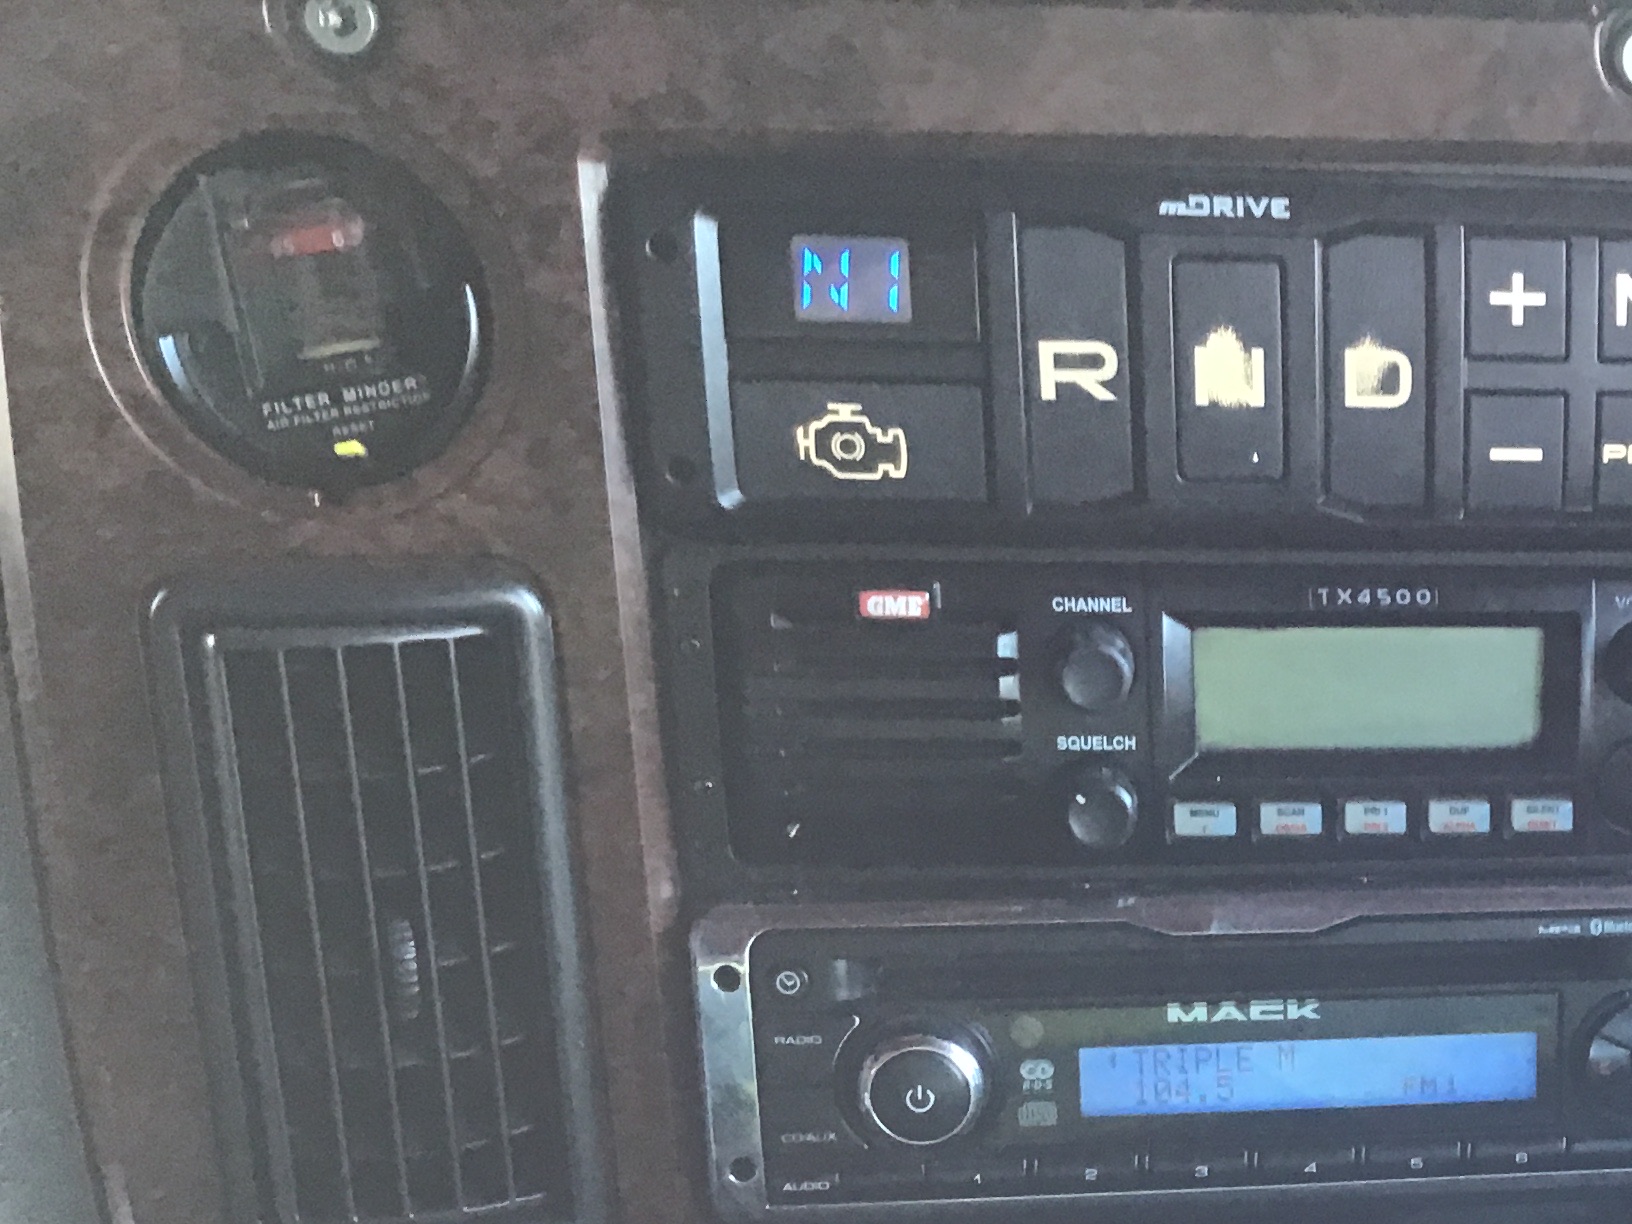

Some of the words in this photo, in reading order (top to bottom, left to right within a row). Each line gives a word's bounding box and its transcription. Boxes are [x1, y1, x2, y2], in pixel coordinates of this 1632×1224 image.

[1158, 194, 1291, 220] mDRIVE
[1038, 339, 1119, 401] R
[1344, 345, 1412, 409] D
[262, 391, 330, 417] FILTER
[341, 376, 418, 403] MINDER
[867, 594, 926, 616] GME
[1052, 596, 1133, 613] CHANNEL
[1317, 587, 1433, 606] TX4500
[1056, 735, 1137, 751] SQUELCH
[1167, 998, 1321, 1024] MACK
[774, 1035, 823, 1045] RADIO
[1133, 1047, 1254, 1077] TRIPLE
[1277, 1045, 1296, 1073] M
[1136, 1073, 1235, 1106] 104.5
[782, 1181, 830, 1191] AUDIO
